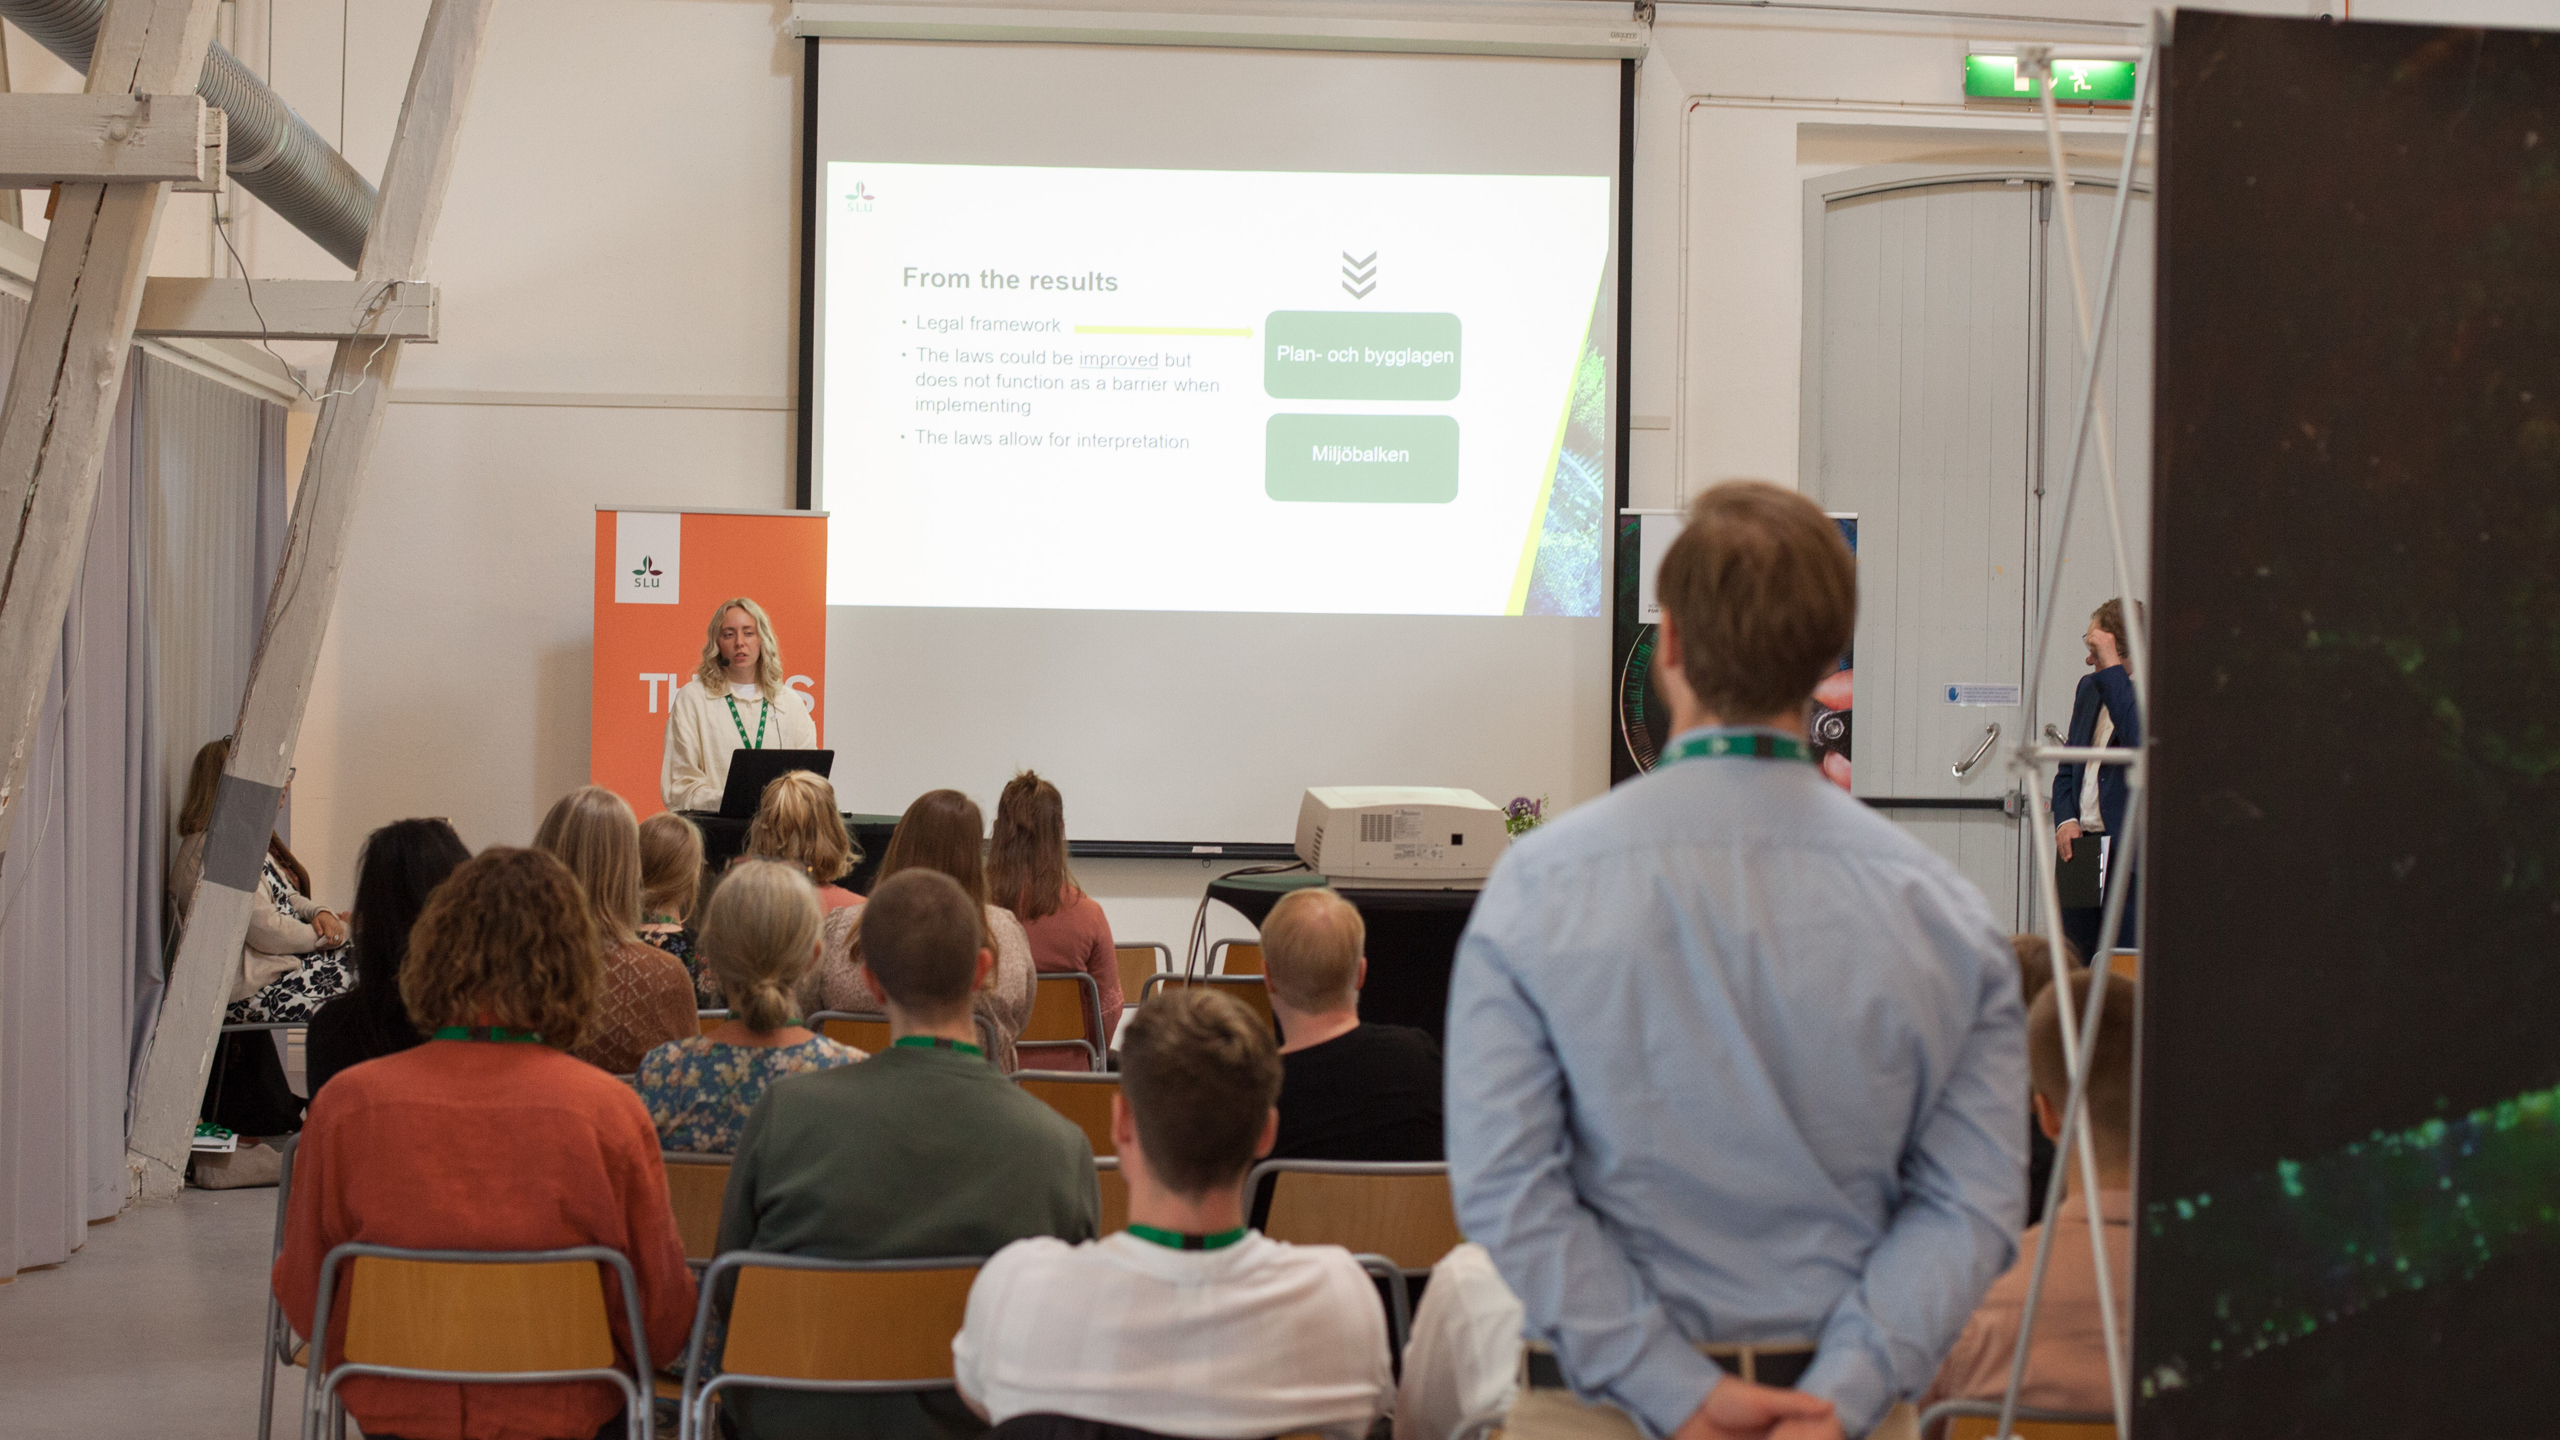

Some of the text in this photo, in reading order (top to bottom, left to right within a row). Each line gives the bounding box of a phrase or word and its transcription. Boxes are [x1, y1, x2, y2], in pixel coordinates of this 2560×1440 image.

[846, 202, 873, 213] SLU
[902, 266, 1119, 292] From the results
[916, 315, 1061, 334] Legal framework
[916, 347, 1192, 368] The laws could be improved but
[1276, 345, 1455, 367] Plan- och bygglagen
[915, 372, 1220, 393] does not function as a barrier when
[915, 396, 1032, 417] implementing
[915, 429, 1190, 451] The laws allow for interpretation
[1311, 445, 1410, 466] Miljöbalken
[634, 577, 660, 588] SLU
